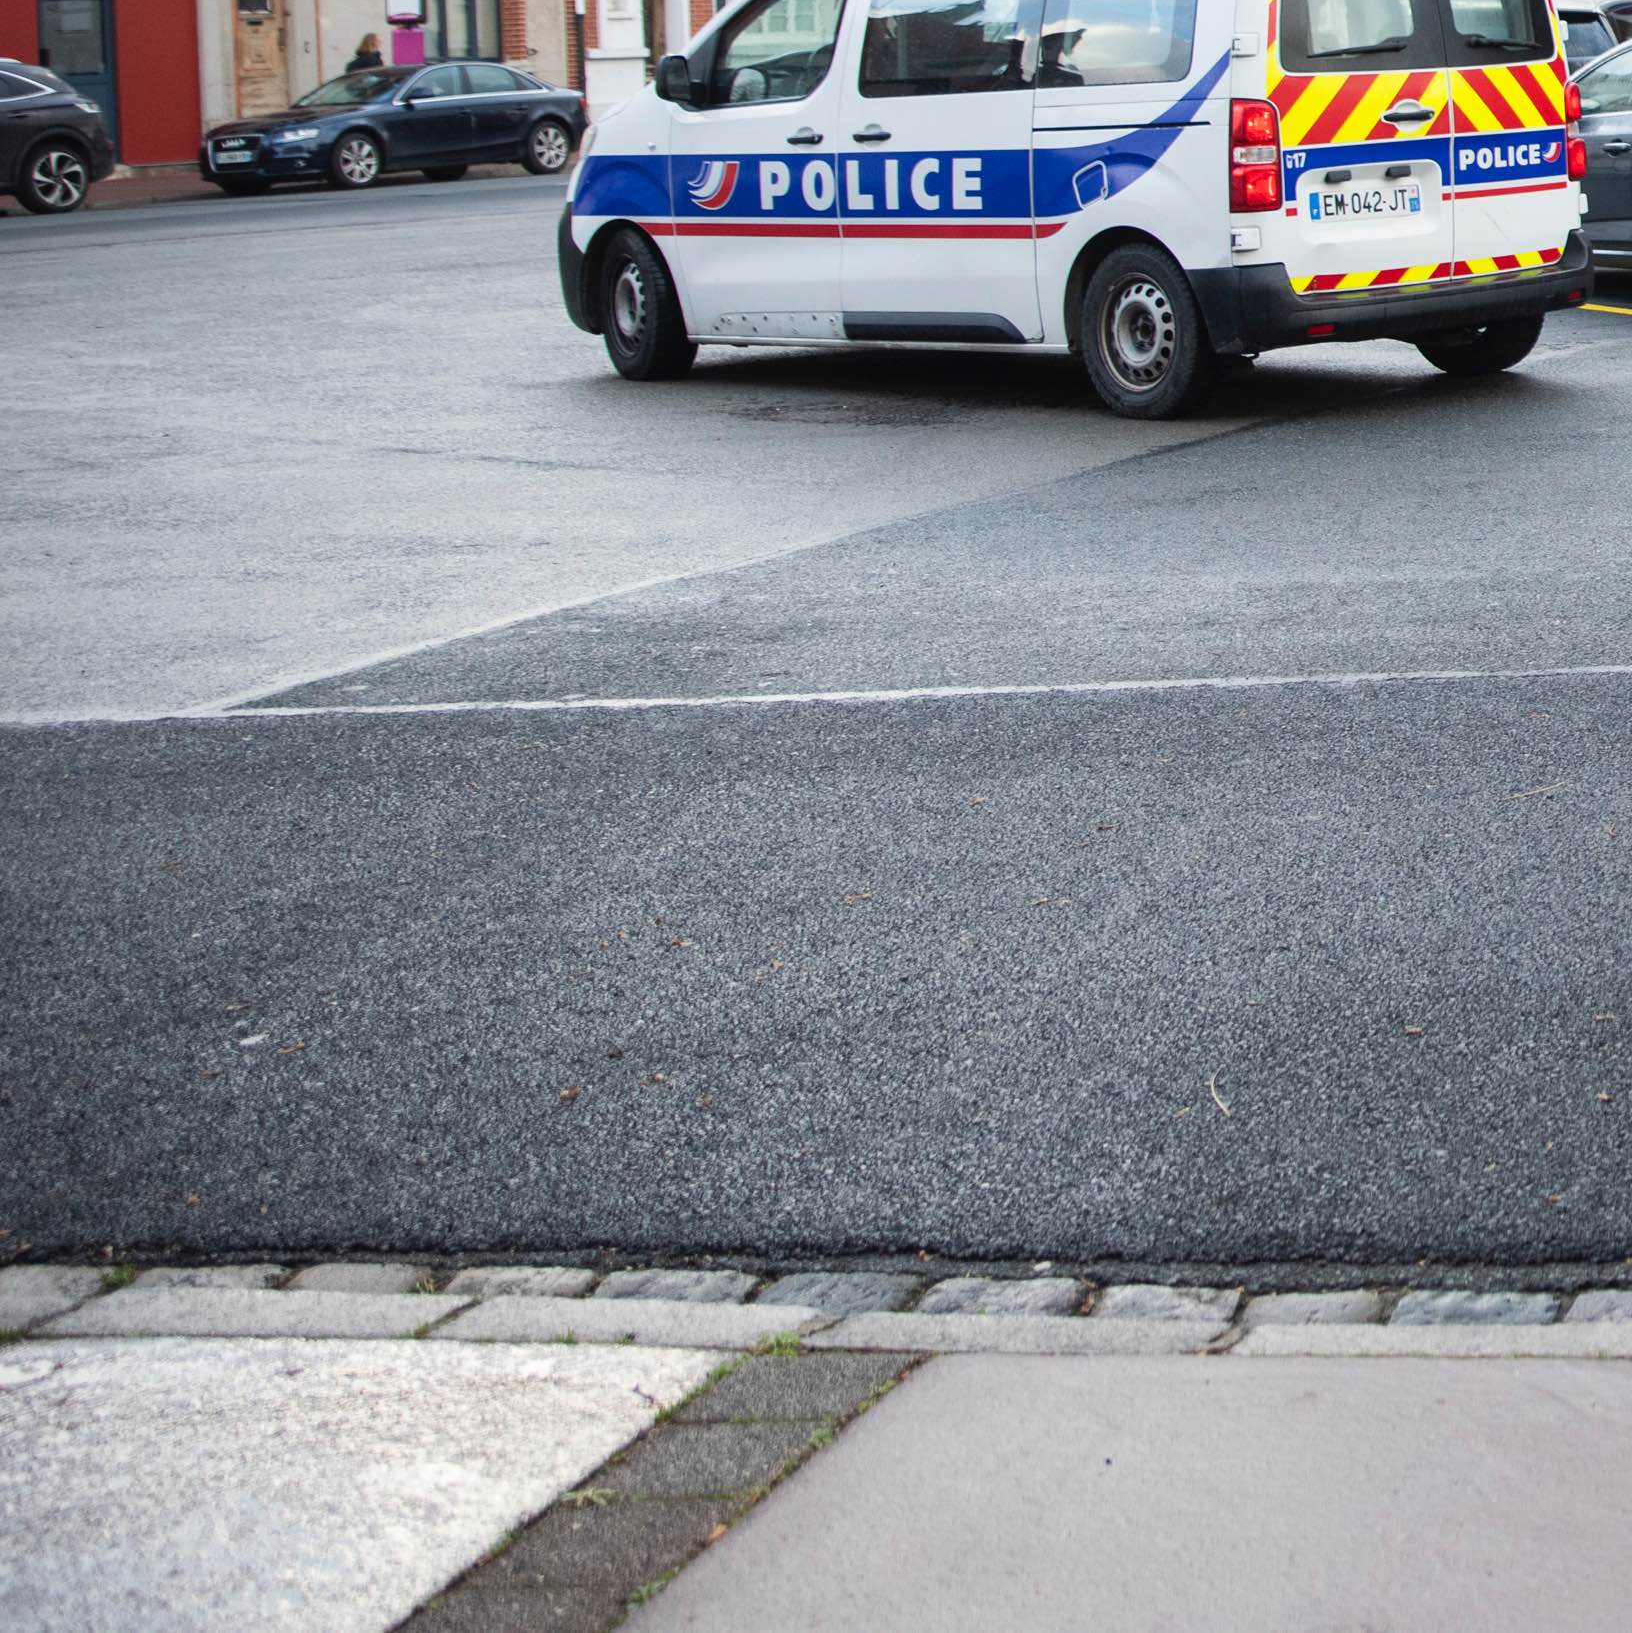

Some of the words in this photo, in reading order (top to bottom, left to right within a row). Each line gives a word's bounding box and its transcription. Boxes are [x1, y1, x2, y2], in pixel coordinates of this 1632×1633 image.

[1458, 143, 1541, 171] POLICE
[759, 158, 983, 211] POLICE
[1323, 189, 1407, 216] EM-042-JT
